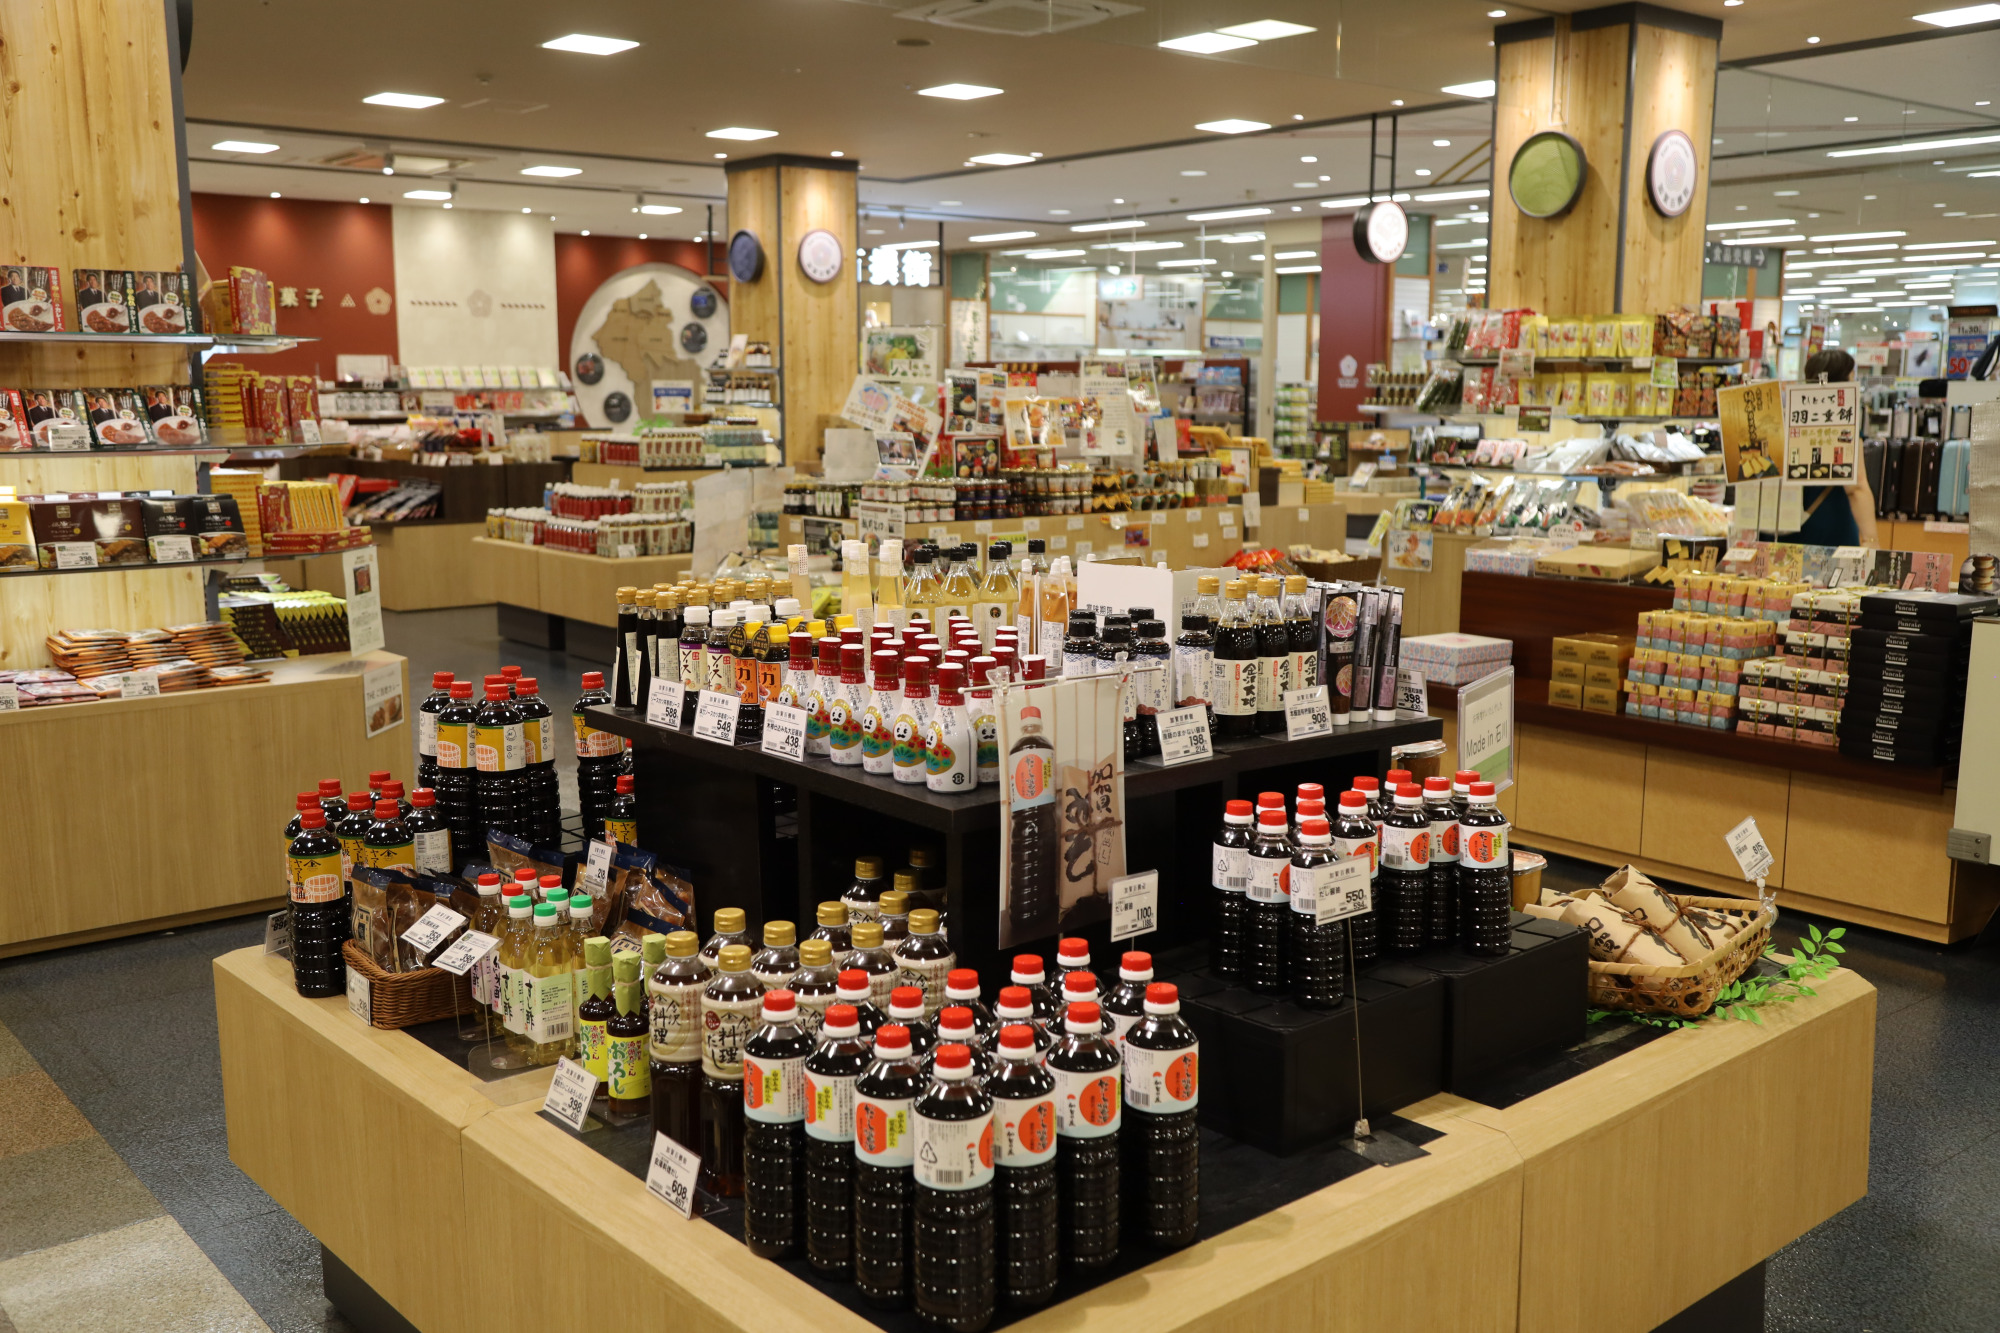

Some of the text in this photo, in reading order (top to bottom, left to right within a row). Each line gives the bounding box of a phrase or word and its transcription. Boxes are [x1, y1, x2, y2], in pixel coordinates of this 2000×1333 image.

[279, 286, 324, 308] 菓子
[1791, 406, 1854, 424] 羽二重餅
[1086, 603, 1113, 615] 賞味期限
[1242, 662, 1258, 707] 金沢大地
[1404, 692, 1420, 704] 398
[665, 707, 678, 718] 588
[1312, 712, 1327, 724] 908
[716, 720, 732, 732] 548
[785, 735, 800, 748] 438
[1189, 734, 1205, 747] 198
[1466, 720, 1508, 759] Made in 石川
[1195, 745, 1206, 753] 214
[597, 868, 606, 879] 218
[1346, 889, 1364, 903] 550
[1137, 906, 1152, 921] 1100
[426, 930, 441, 942] 358
[460, 953, 475, 964] 398
[525, 979, 535, 1031] すし酢
[653, 1007, 668, 1046] 料理
[718, 1025, 739, 1064] 料理
[611, 1041, 626, 1095] おろし
[568, 1097, 583, 1113] 398
[672, 1180, 688, 1200] 608
